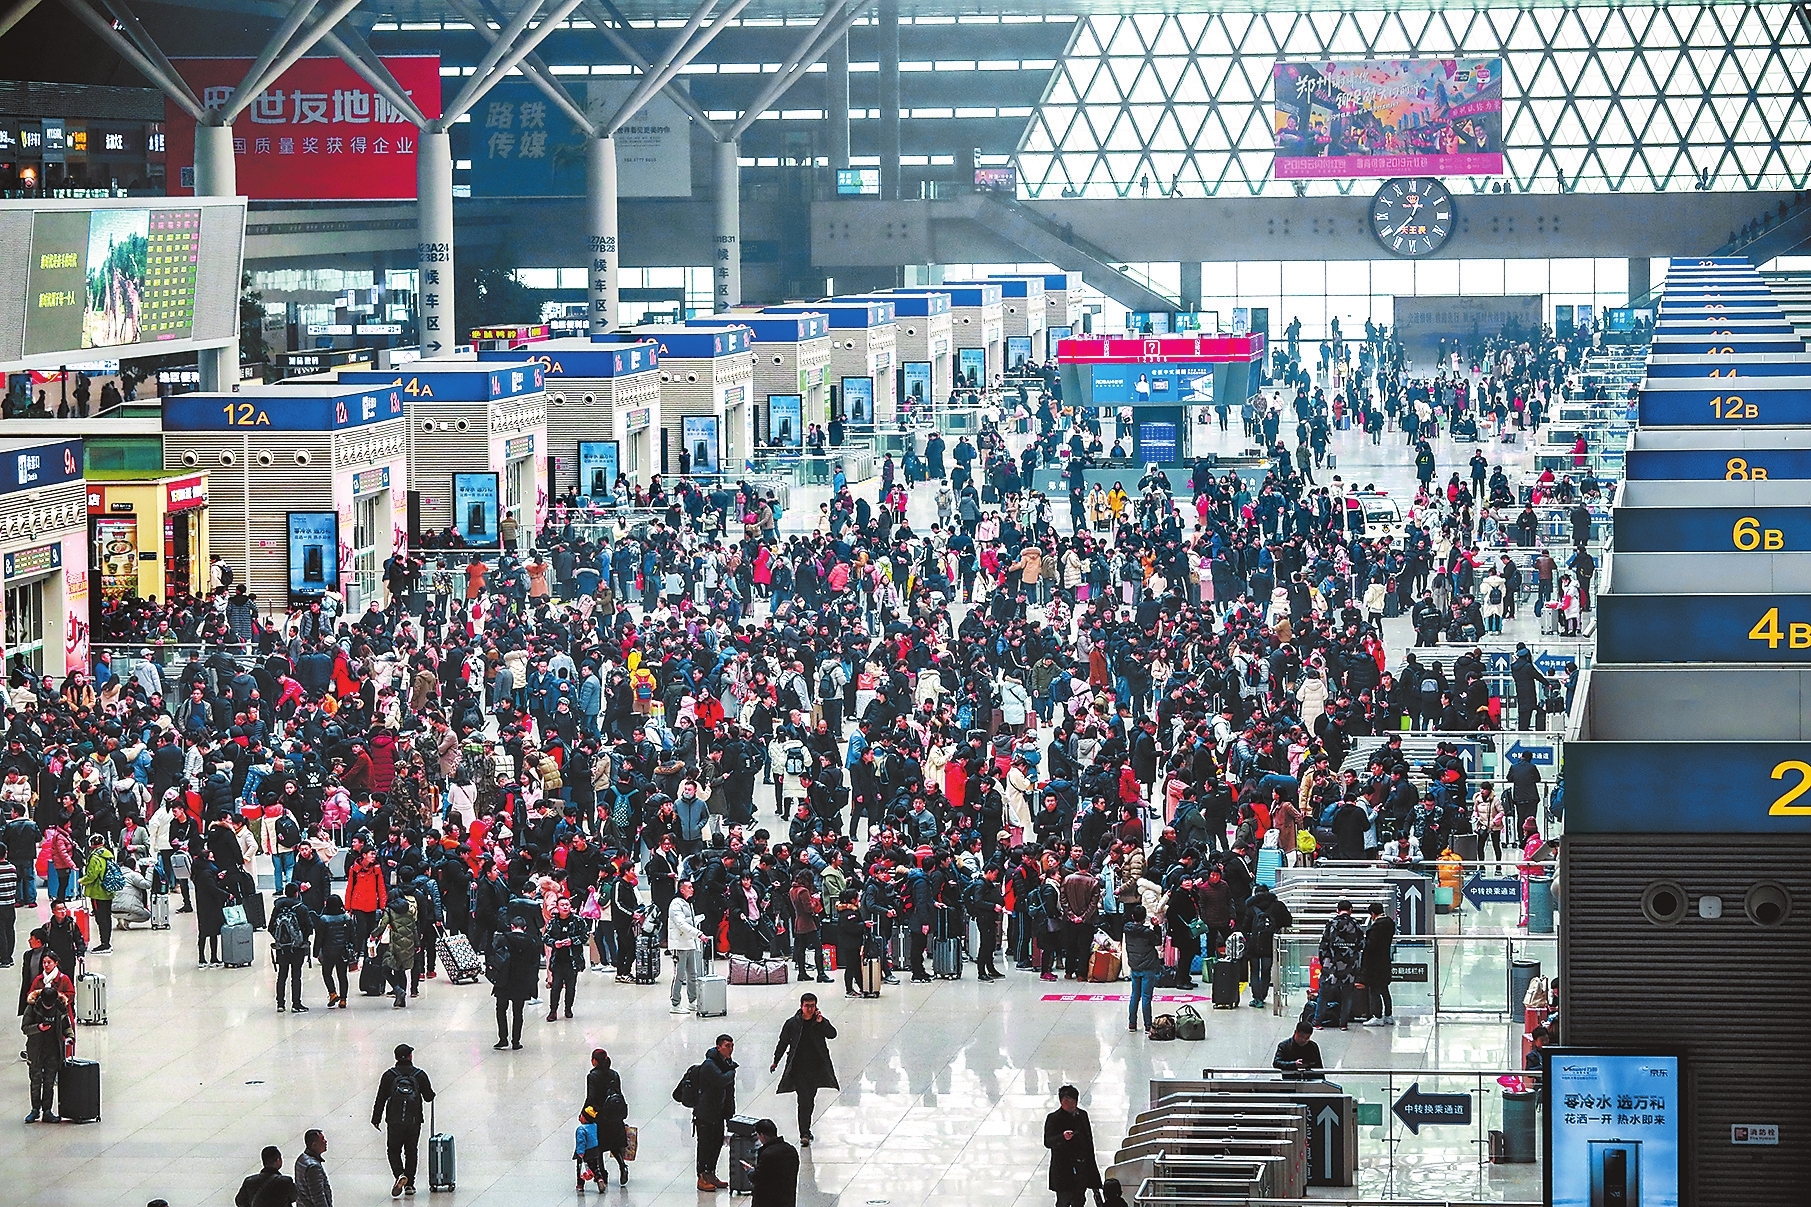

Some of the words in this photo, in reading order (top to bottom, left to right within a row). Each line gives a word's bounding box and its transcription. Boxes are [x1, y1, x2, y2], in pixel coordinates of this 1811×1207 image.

[250, 88, 413, 124] 世友地板
[485, 101, 546, 129] 路铁
[487, 131, 547, 159] 传媒
[593, 258, 608, 311] 候车区
[717, 248, 729, 295] 候车区
[425, 269, 440, 331] 候车区
[223, 403, 271, 426] 12A
[1709, 395, 1759, 419] 12B
[64, 448, 76, 475] 9A
[1725, 457, 1768, 481] 8B
[1732, 516, 1785, 551] 6B
[1748, 607, 1811, 649] 4B
[1768, 759, 1811, 816] 2
[1470, 886, 1516, 896] 中转换乘通道
[1650, 1069, 1668, 1077] 京东
[1404, 1104, 1464, 1116] 中转换乘通道
[1564, 1093, 1612, 1109] 零冷水
[1617, 1094, 1665, 1110] 选万和
[1564, 1113, 1612, 1125] 花洒一开
[1617, 1114, 1665, 1125] 热水即来
[1750, 1128, 1775, 1136] 消防栓
